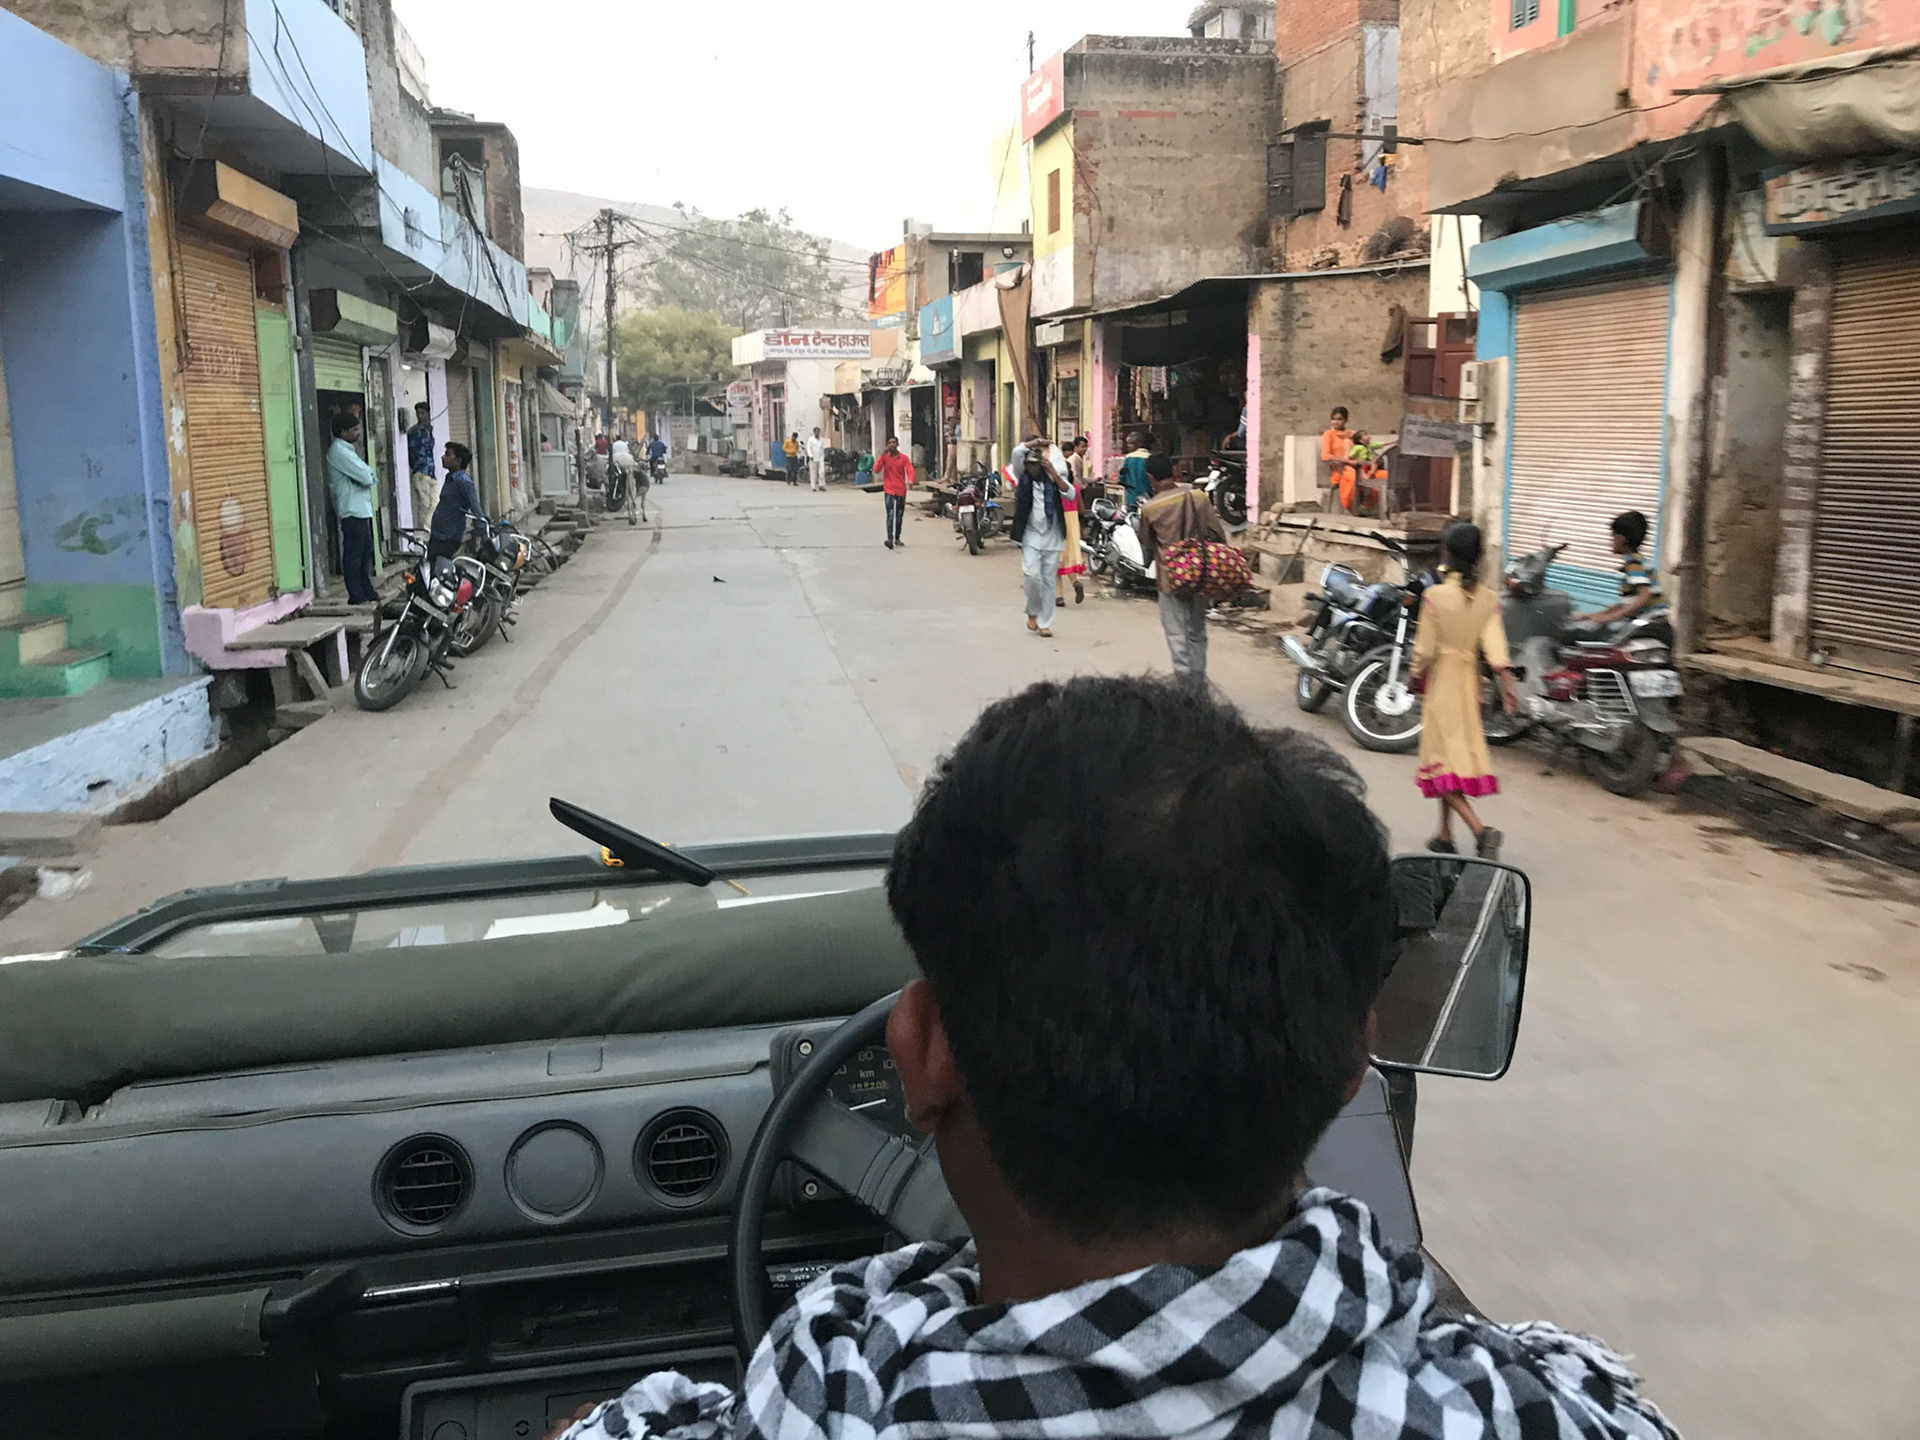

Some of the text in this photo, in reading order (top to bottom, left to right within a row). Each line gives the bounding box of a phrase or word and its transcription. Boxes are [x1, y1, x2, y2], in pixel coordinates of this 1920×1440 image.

[764, 329, 869, 348] डॉन टेन्ट हाऊस
[858, 1050, 873, 1061] 80
[882, 1058, 897, 1070] 10
[860, 1069, 875, 1078] km
